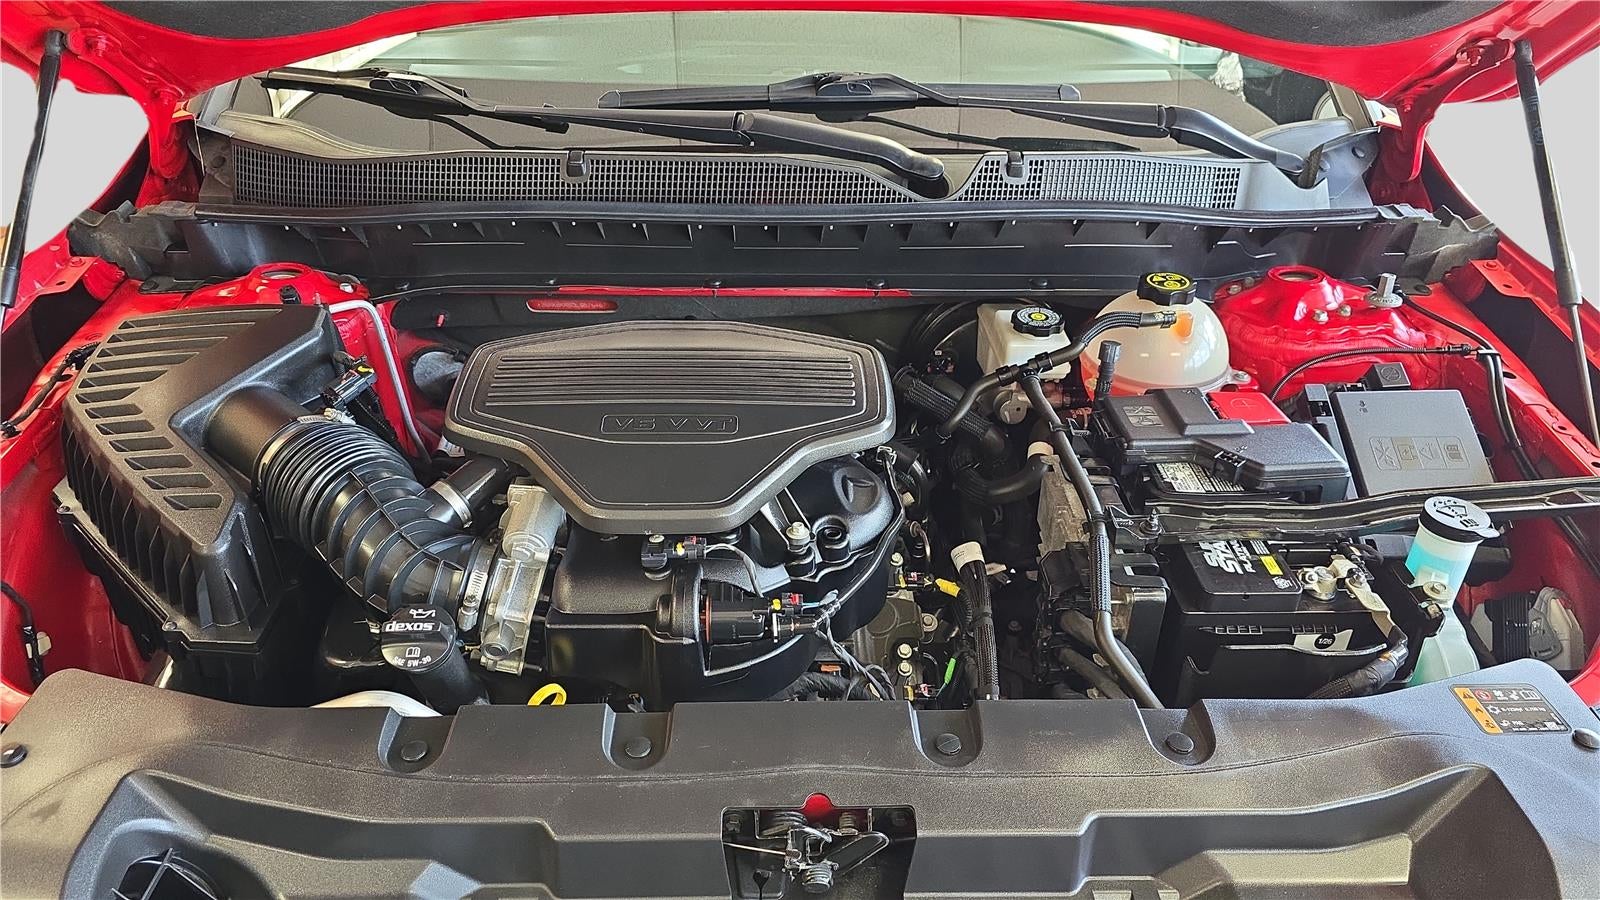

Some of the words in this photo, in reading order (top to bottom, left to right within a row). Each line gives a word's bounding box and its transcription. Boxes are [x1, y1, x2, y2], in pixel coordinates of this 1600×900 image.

[615, 418, 656, 430] V6
[669, 418, 733, 430] VVT
[385, 621, 435, 632] dexos
